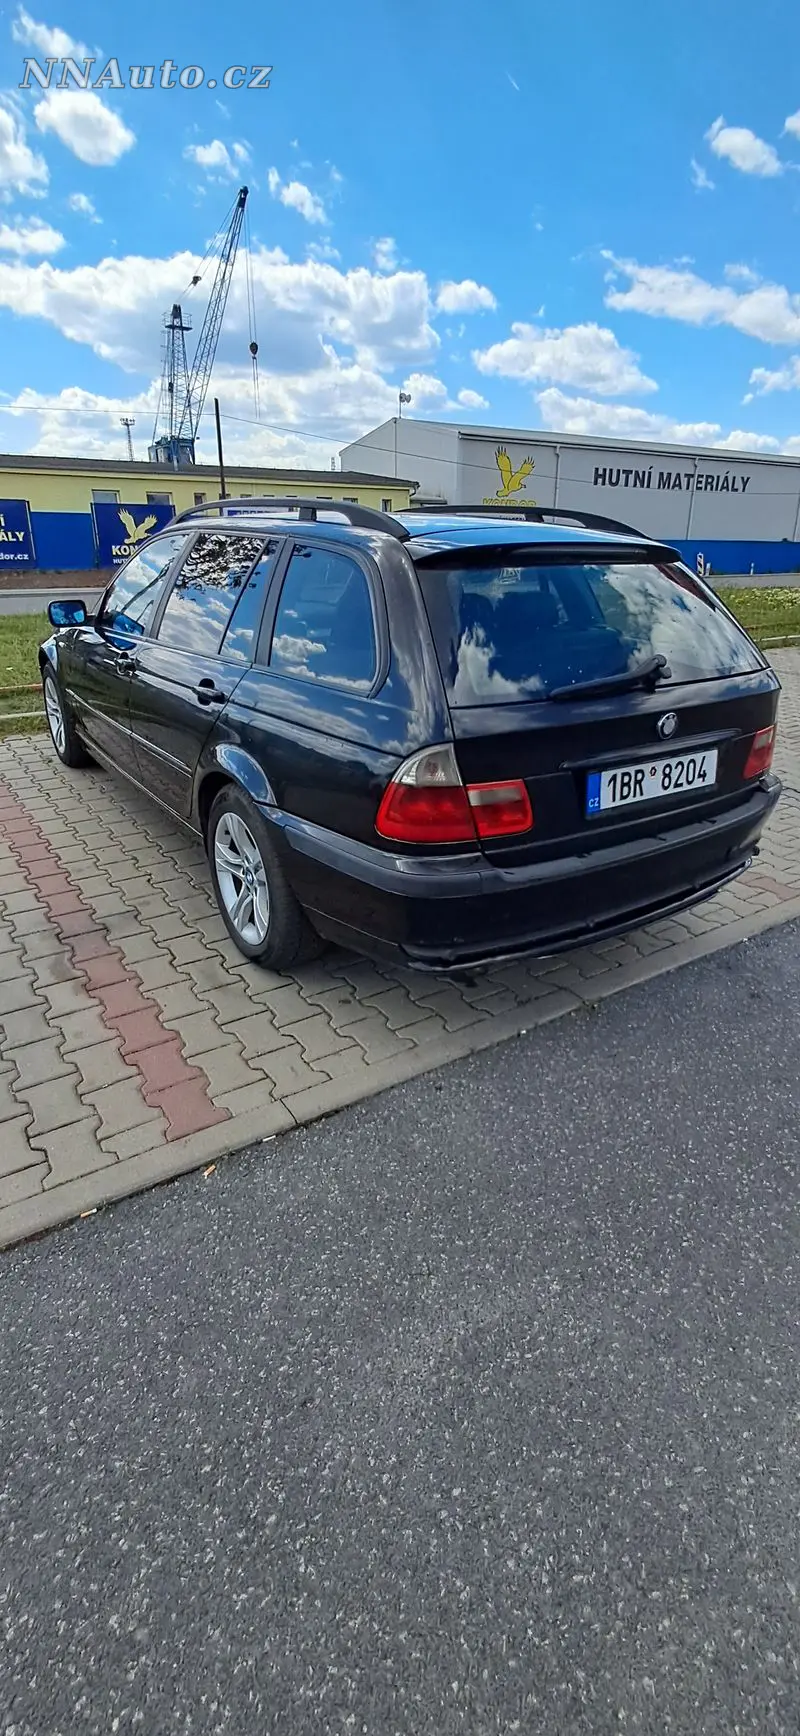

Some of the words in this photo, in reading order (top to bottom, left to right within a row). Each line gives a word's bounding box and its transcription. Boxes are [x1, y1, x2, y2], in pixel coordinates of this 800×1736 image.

[593, 466, 653, 489] HUTNÍ
[656, 471, 751, 493] MATERIÁLY
[607, 769, 645, 803] 1BR
[660, 755, 707, 790] 8204
[588, 797, 599, 808] CZ
